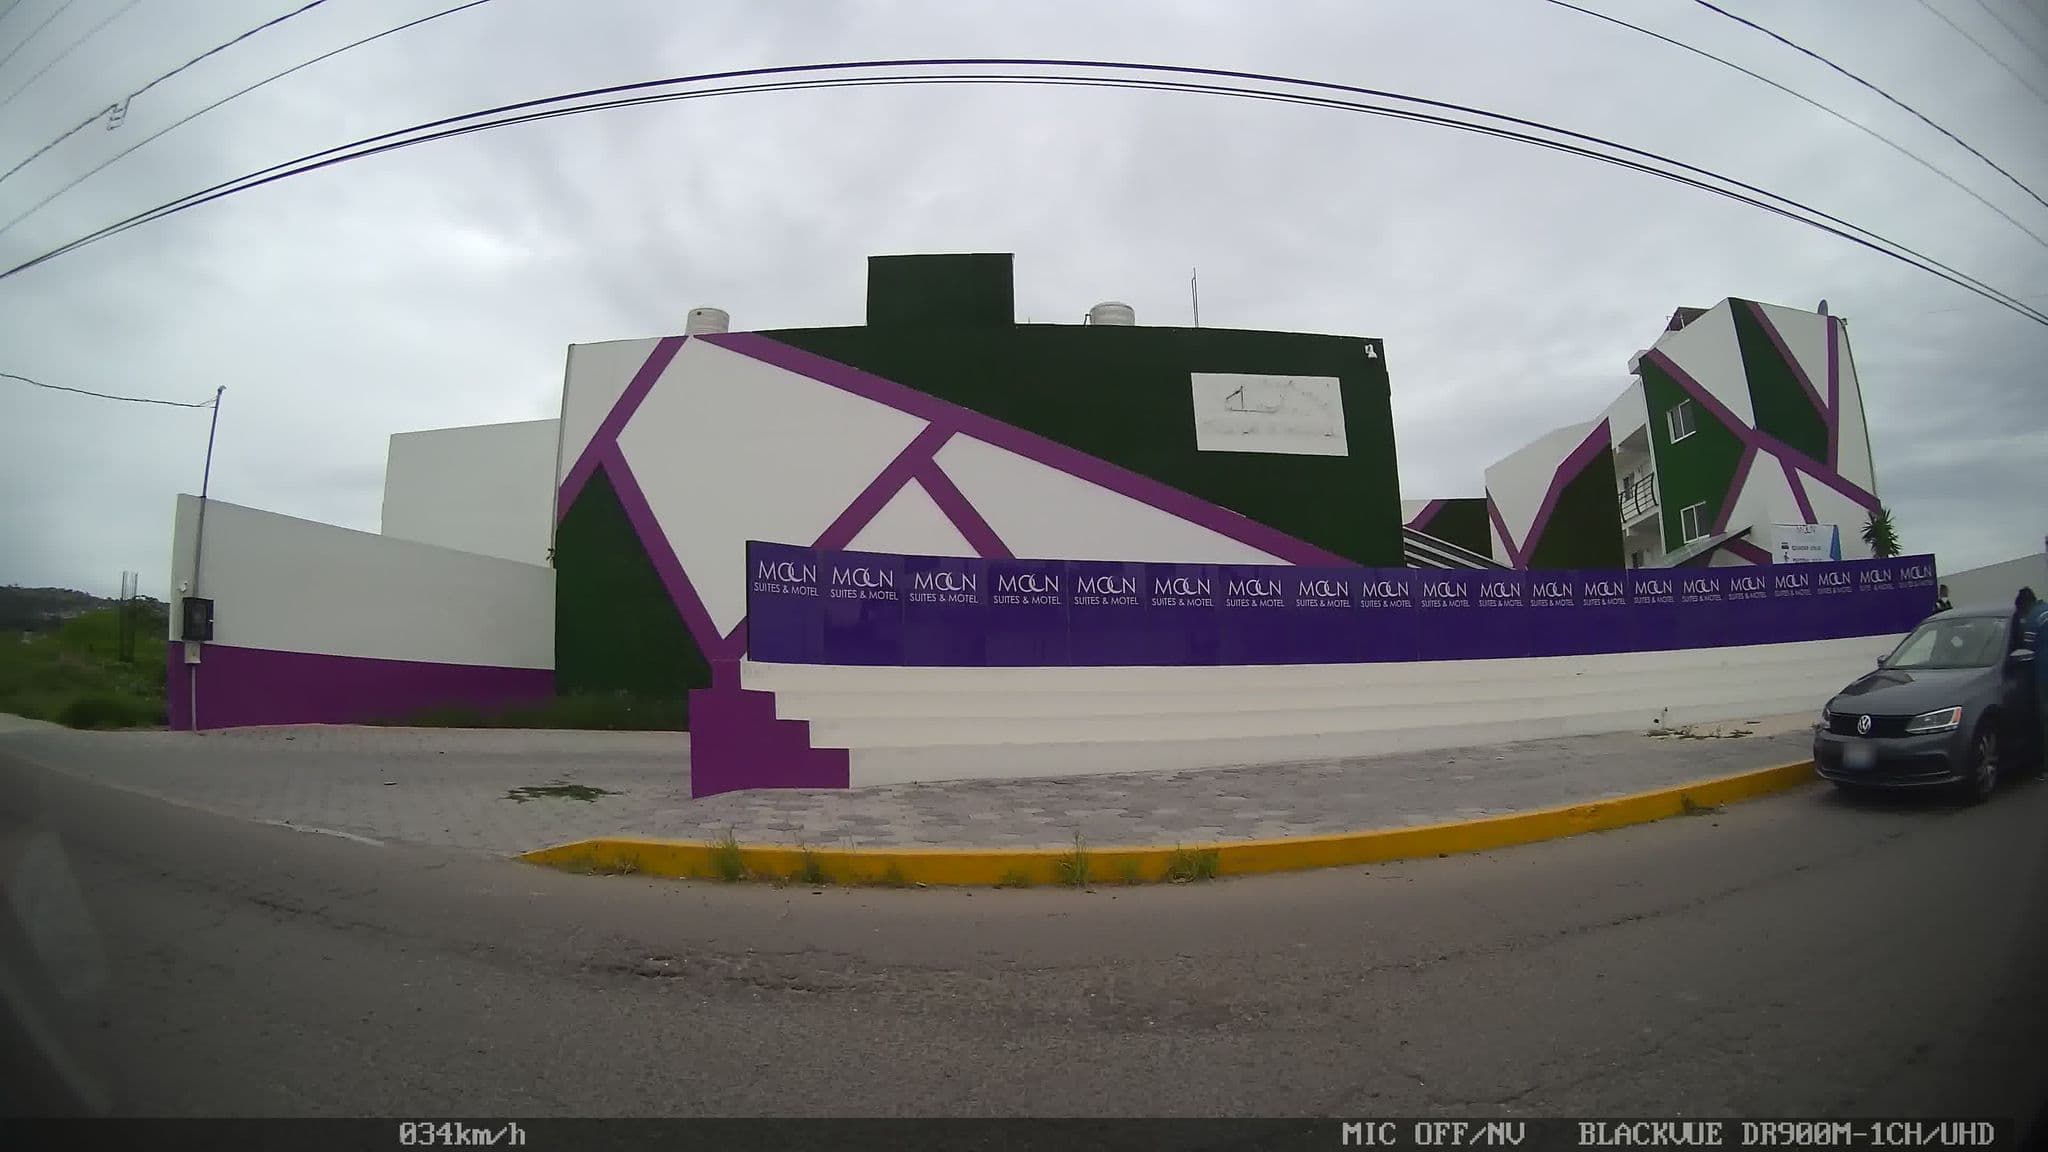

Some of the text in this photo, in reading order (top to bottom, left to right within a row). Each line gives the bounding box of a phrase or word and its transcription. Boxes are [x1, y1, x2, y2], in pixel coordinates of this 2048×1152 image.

[753, 582, 819, 596] SUITES & MOTEL
[830, 589, 899, 600] SUITES & MOTEL
[909, 593, 979, 604] SUITES & MOTEL
[993, 595, 1060, 605] SUITES & MOTEL
[1073, 596, 1139, 605] SUITES & MOTEL
[1151, 597, 1213, 606] SUITES & MOTEL
[1226, 598, 1285, 607] SUITES & MOTEL
[1296, 599, 1351, 607] SUITES & MOTEL
[1390, 600, 1412, 608] MOTEL
